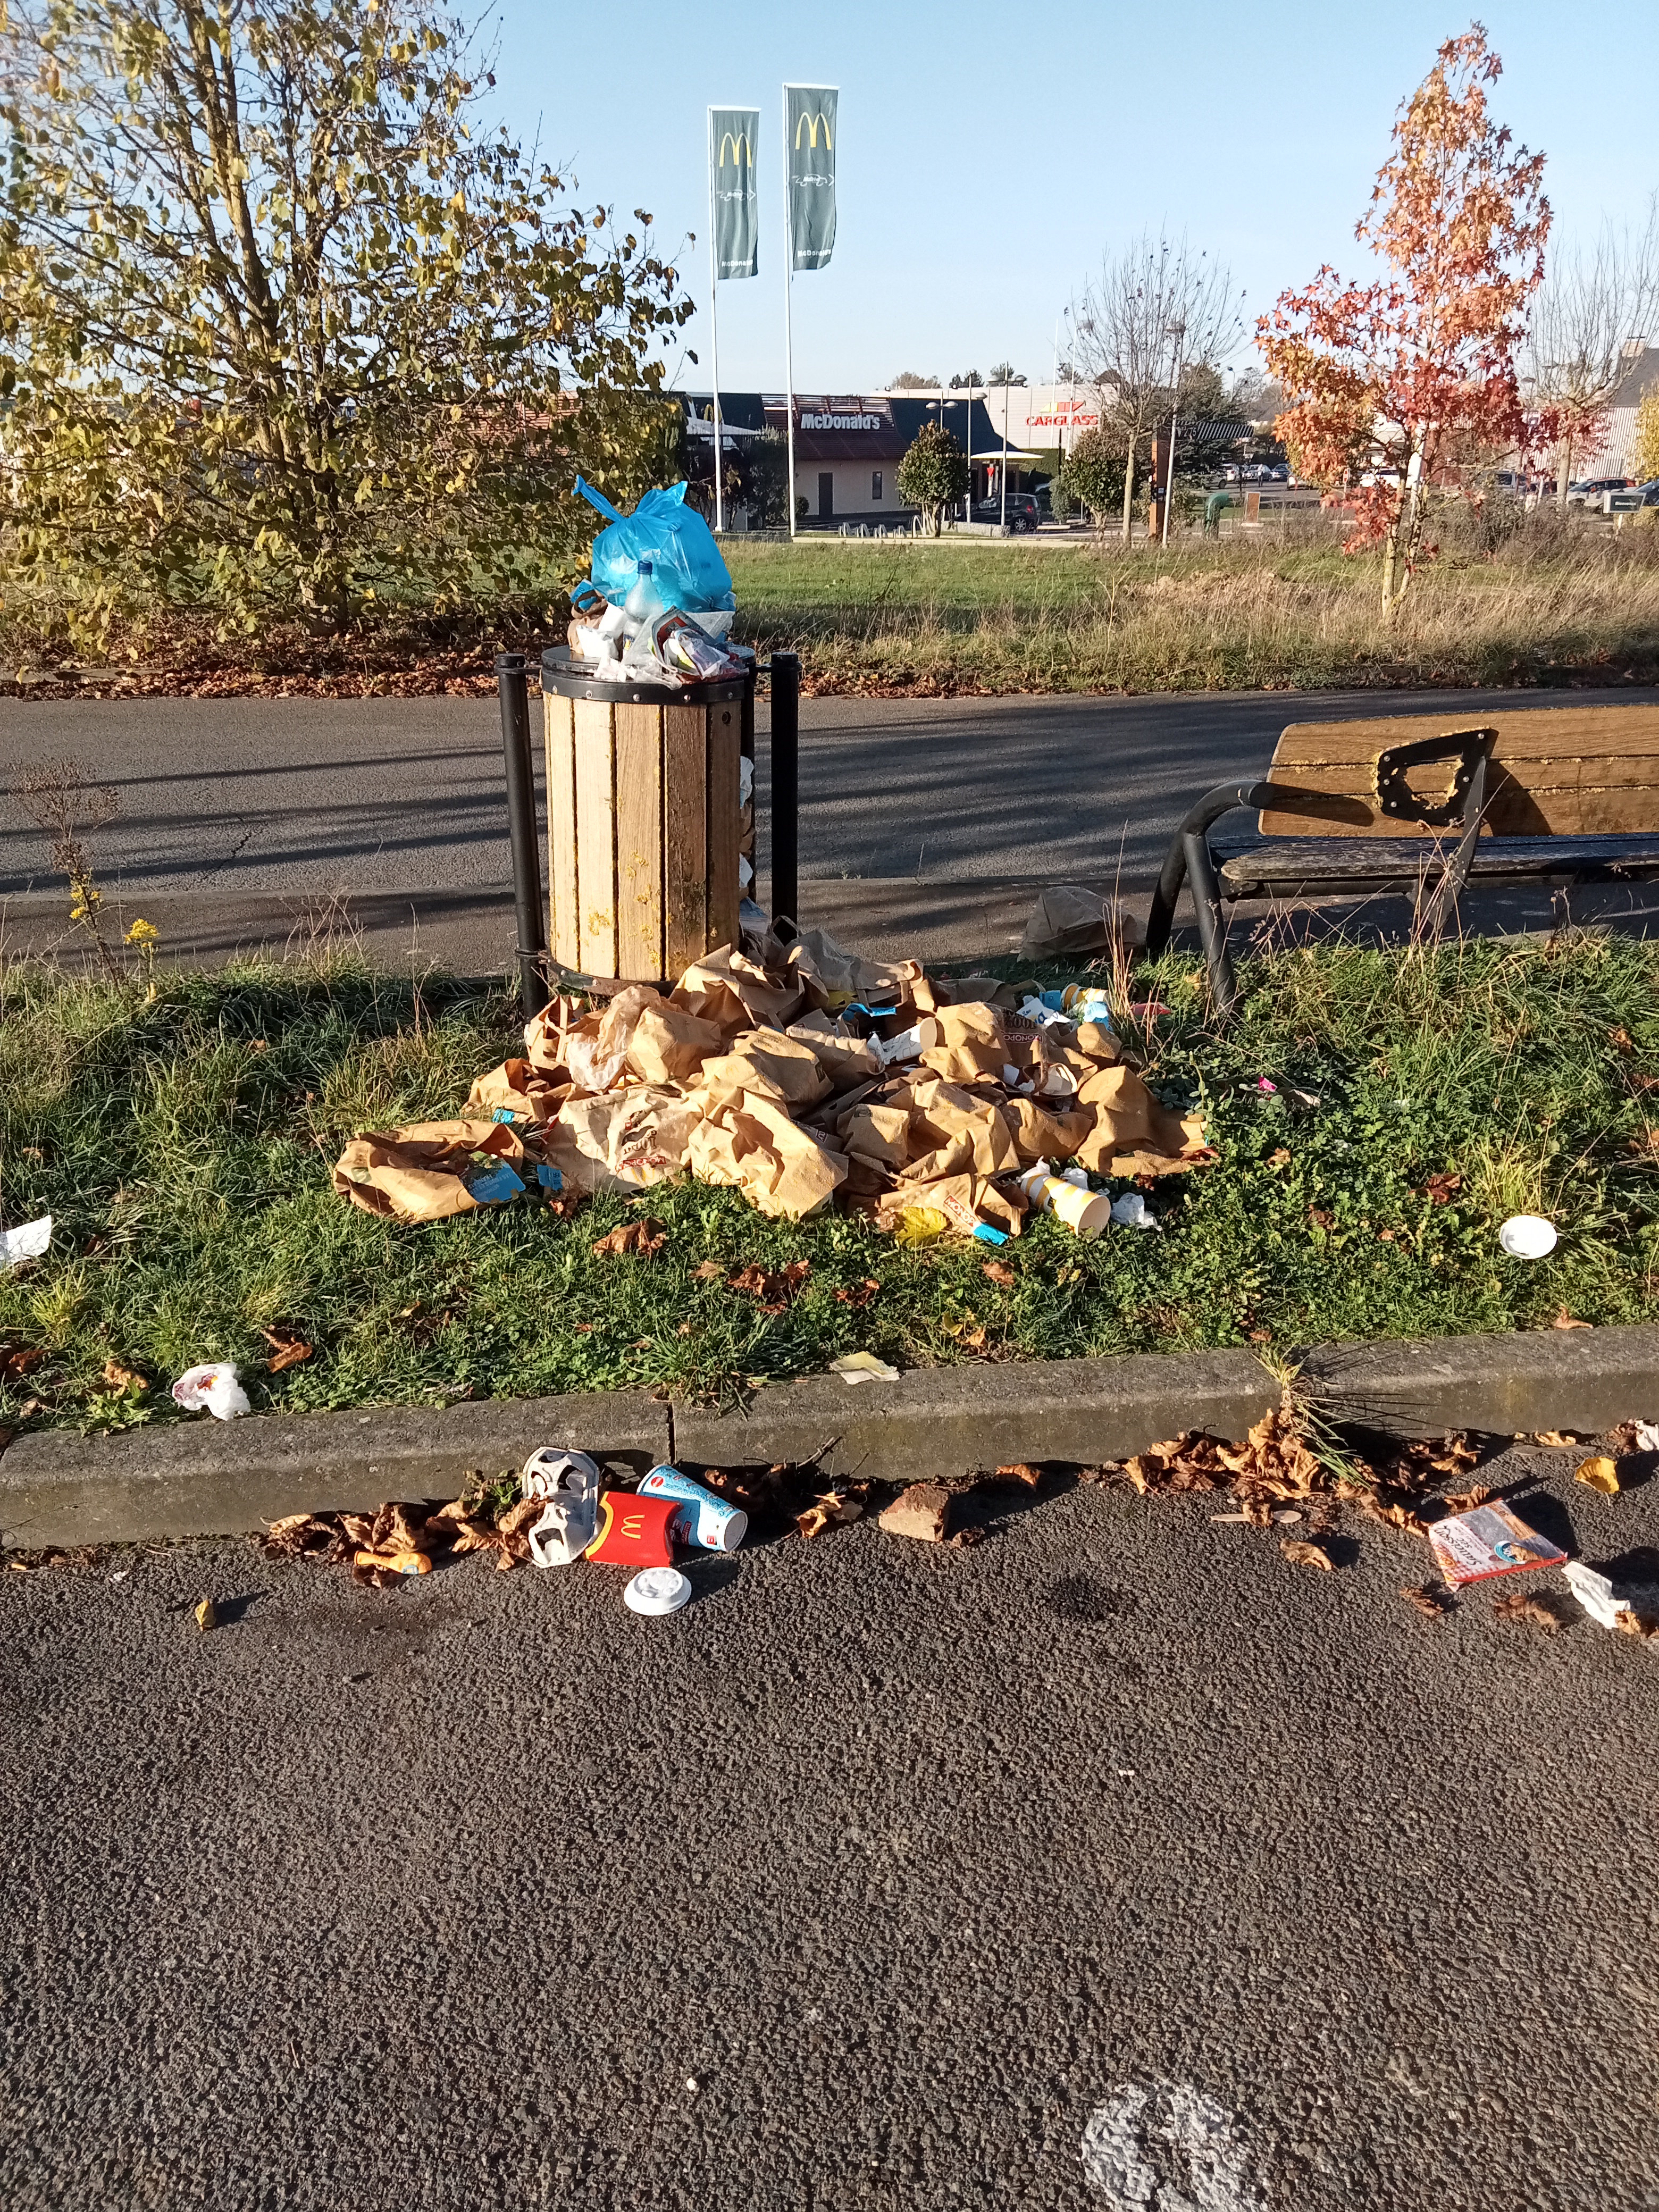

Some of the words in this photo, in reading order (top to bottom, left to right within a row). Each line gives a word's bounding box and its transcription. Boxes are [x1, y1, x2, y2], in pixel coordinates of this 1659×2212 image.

[800, 414, 881, 430] McDonald's
[1025, 415, 1099, 426] CARGLASS
[945, 1197, 976, 1225] MONOP
[1434, 1526, 1482, 1566] Saucisson
[1456, 1537, 1472, 1548] sec
